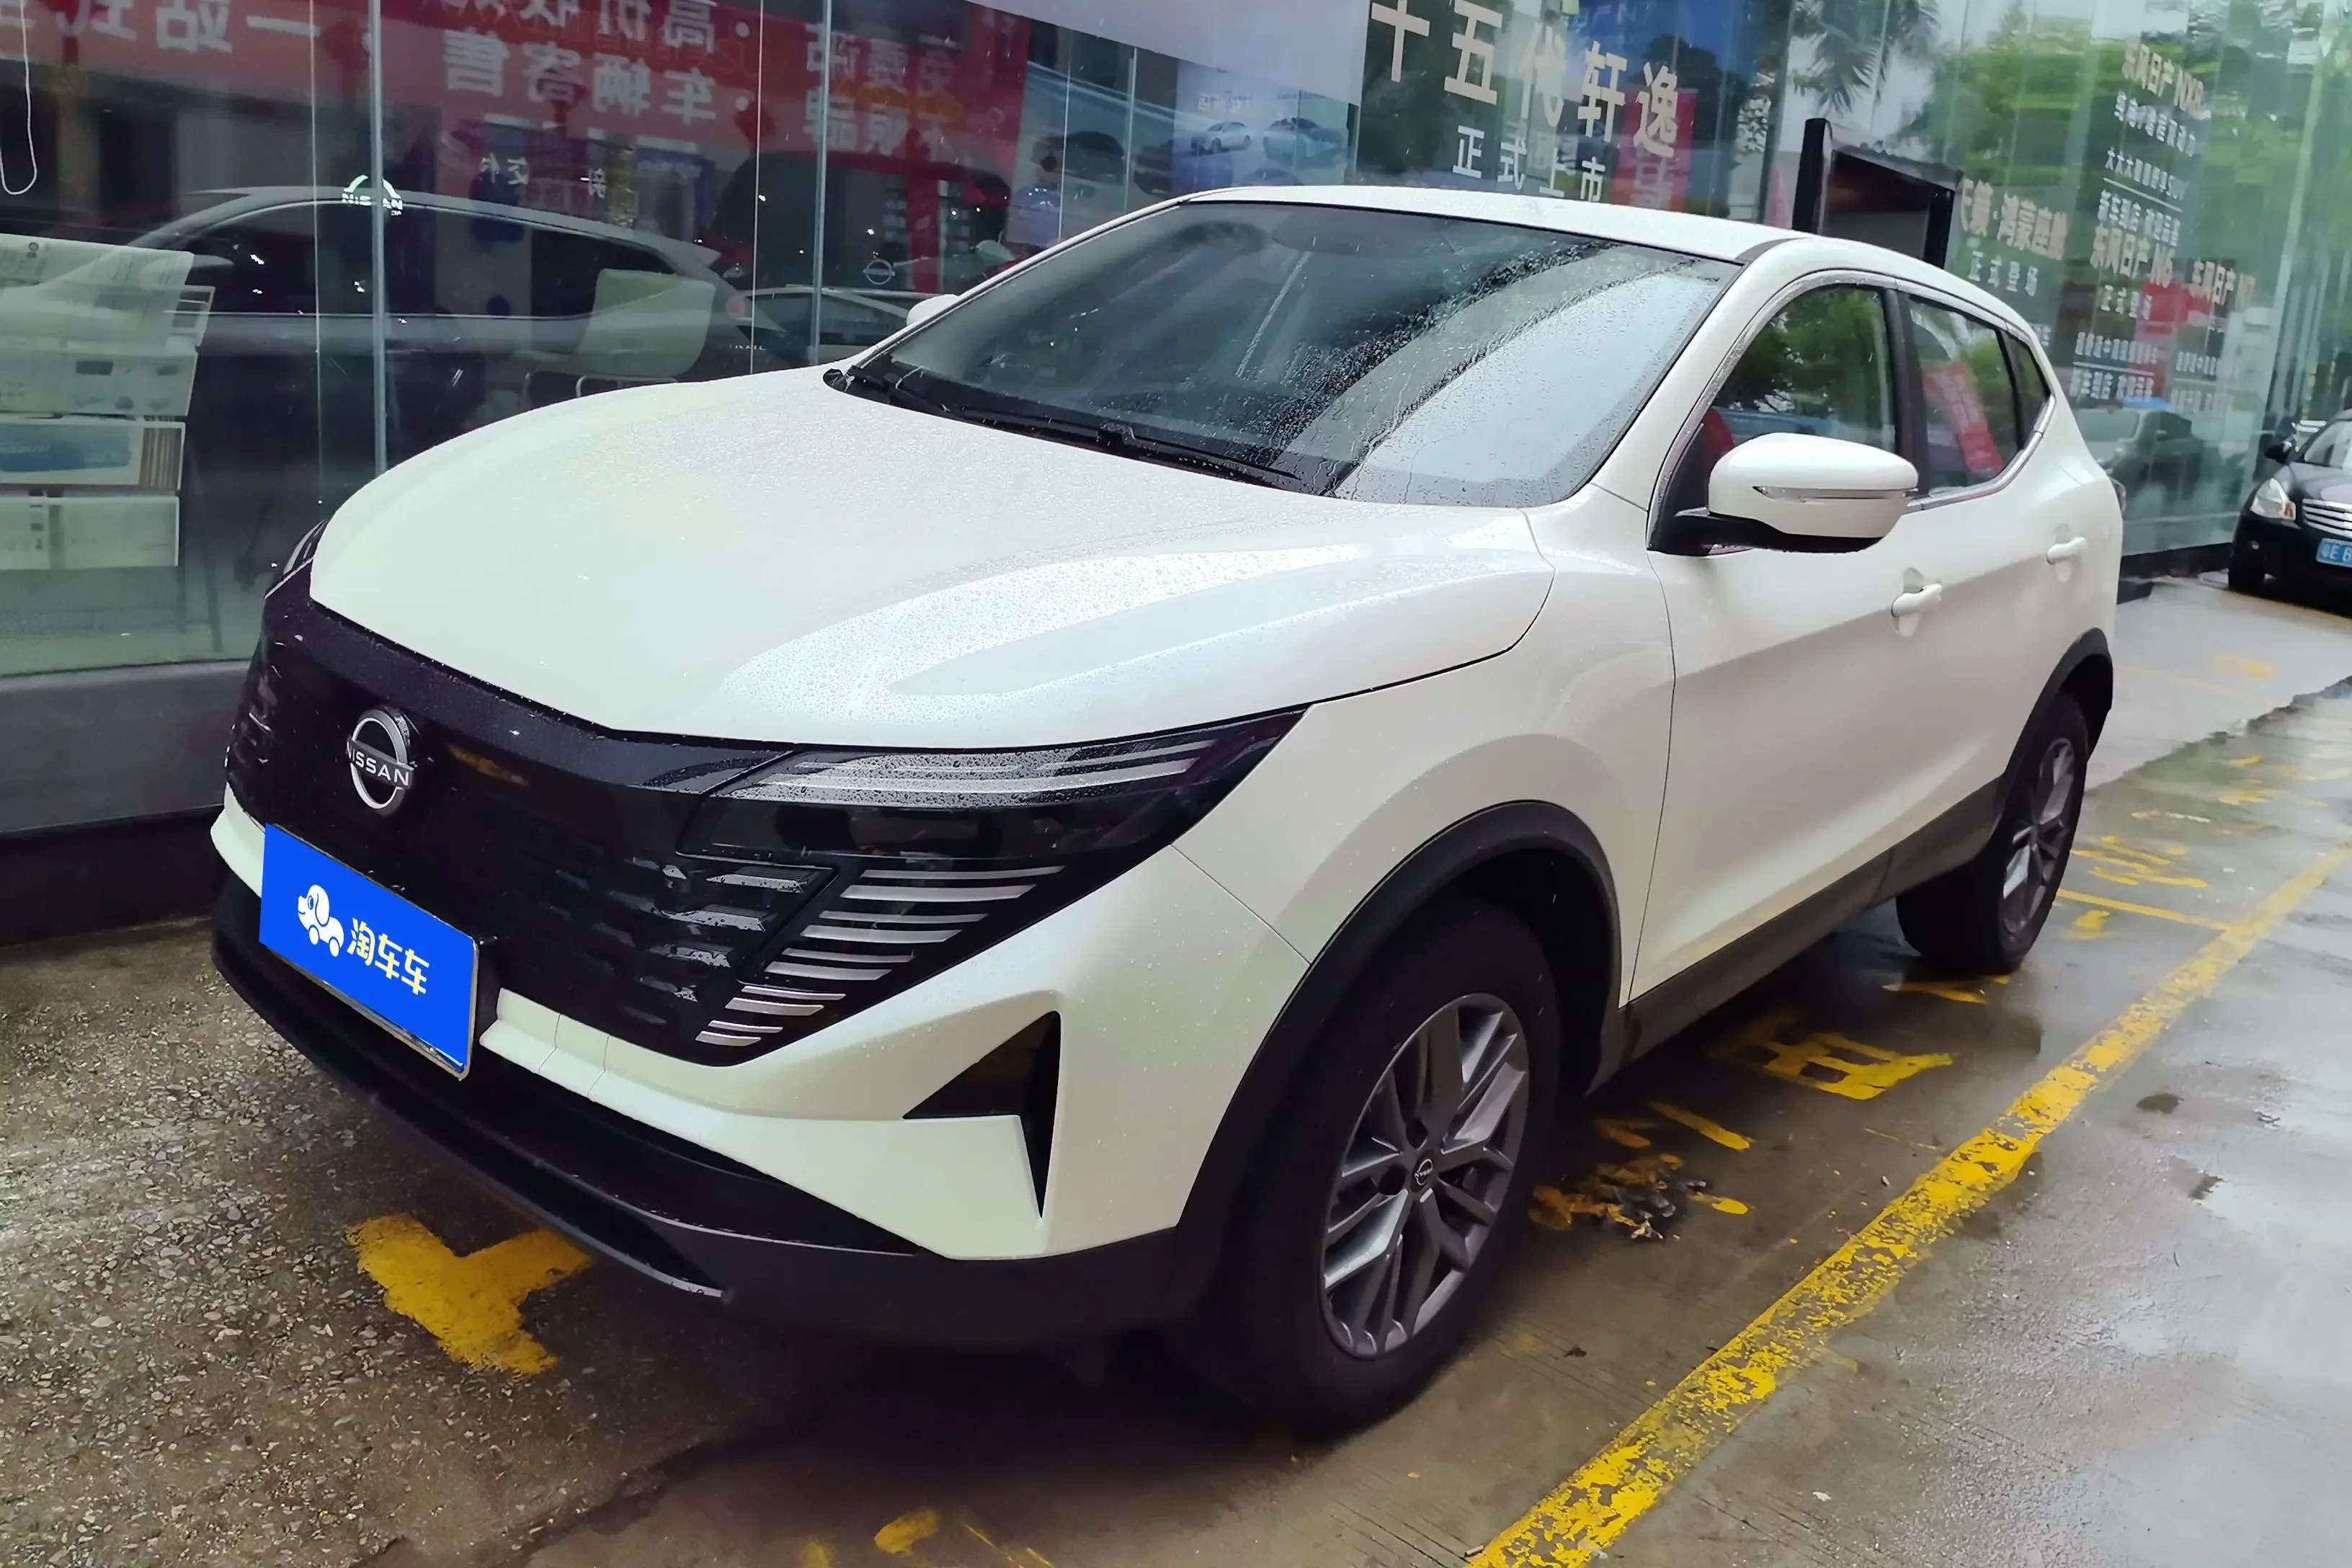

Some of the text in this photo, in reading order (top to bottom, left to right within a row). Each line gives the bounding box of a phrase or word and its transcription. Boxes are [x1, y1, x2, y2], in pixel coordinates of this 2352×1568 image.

[1371, 0, 1680, 158] 十五代轩逸
[1452, 125, 1606, 202] 正式上市
[342, 192, 403, 210] NISAN
[346, 743, 409, 787] NISSAN
